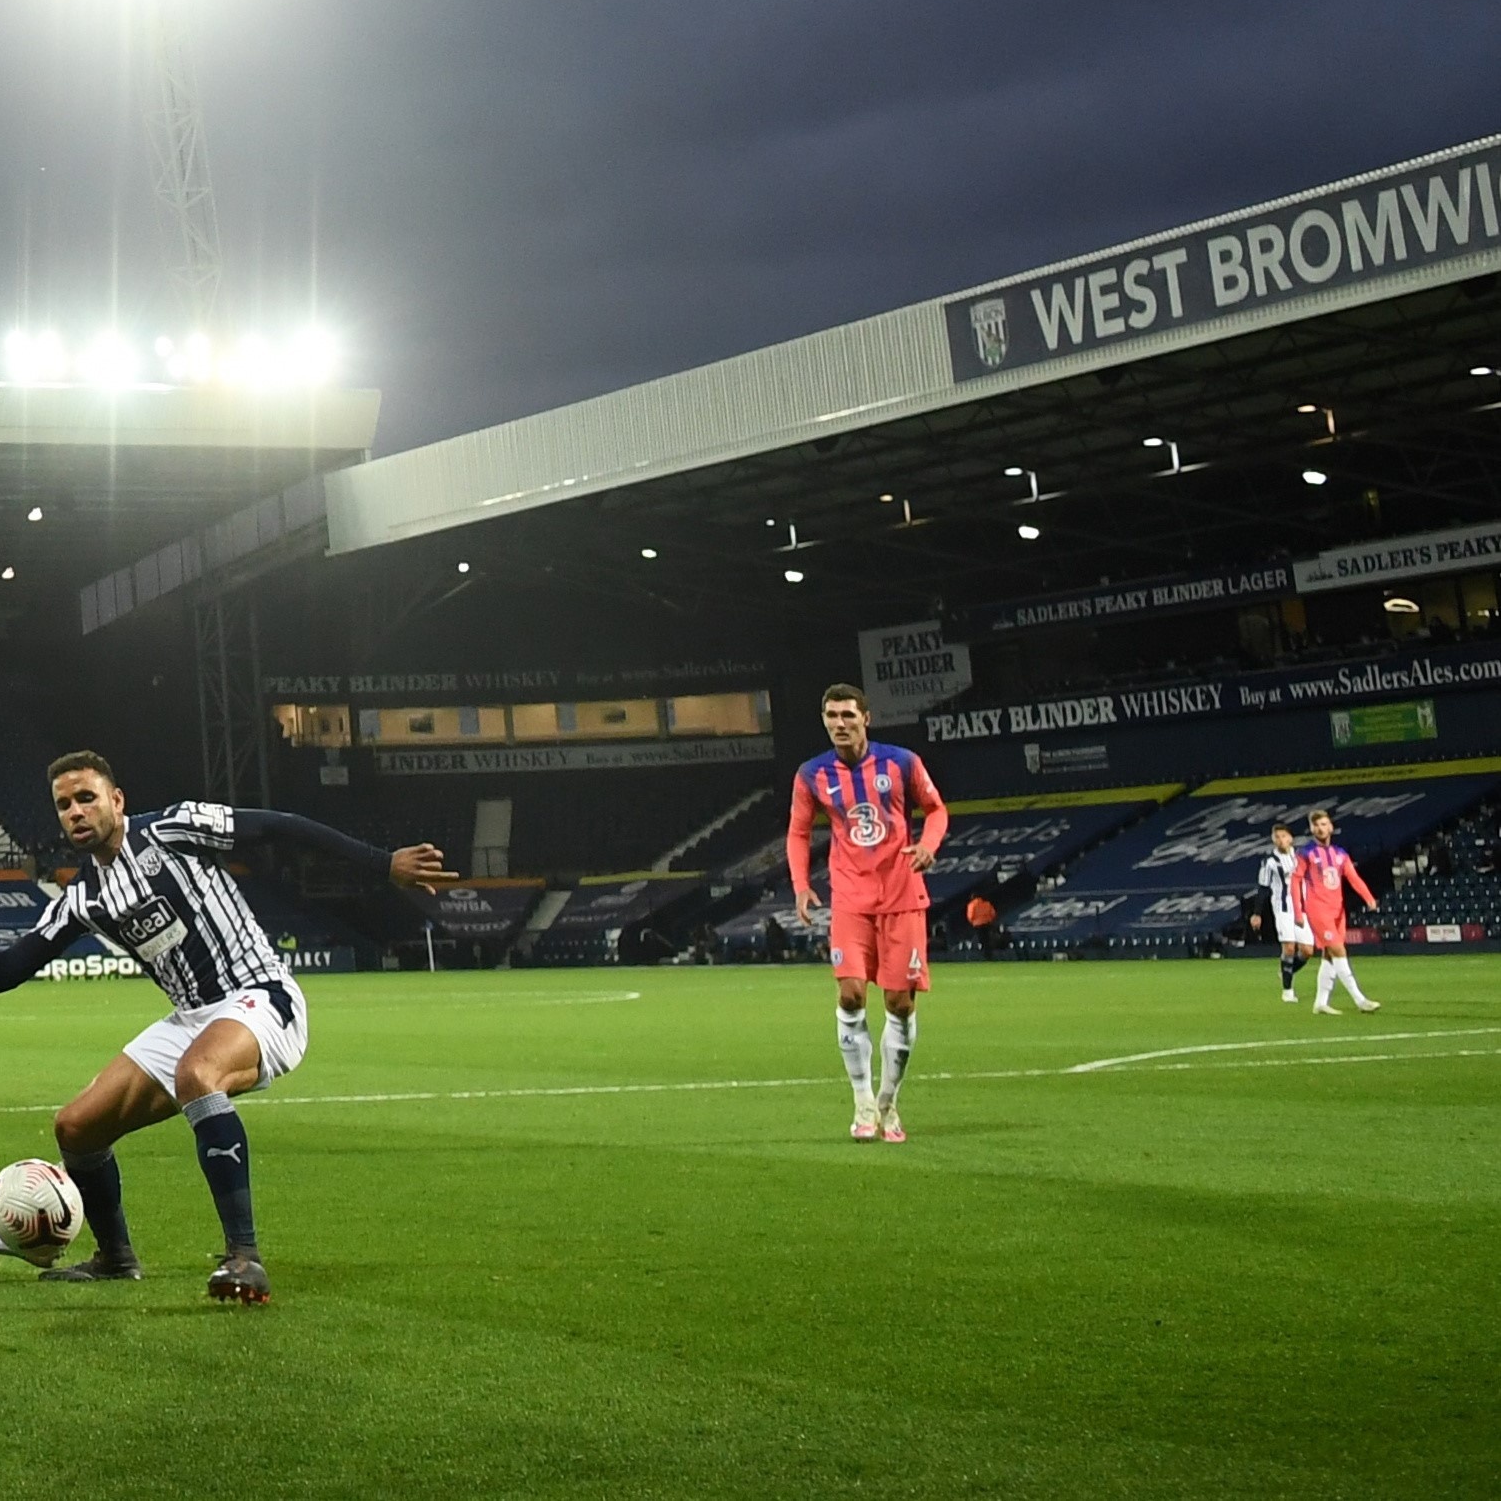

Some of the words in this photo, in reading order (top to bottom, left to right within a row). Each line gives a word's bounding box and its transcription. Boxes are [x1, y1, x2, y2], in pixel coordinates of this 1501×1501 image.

[1031, 248, 1188, 352] WEST
[1206, 162, 1501, 308] BROMWI
[1337, 545, 1433, 577] SADLER'S
[1016, 598, 1093, 627] SADLER'S
[1094, 589, 1149, 616] PEAKY
[1151, 577, 1225, 606] BLINDER
[1228, 568, 1288, 595] LAGER
[882, 629, 944, 658] PEAKY
[875, 652, 956, 682] BLINDER
[265, 675, 342, 693] PEAKY
[350, 674, 459, 692] BLINDER
[926, 708, 1001, 742] PEAKY
[1008, 695, 1117, 734] BLINDER
[1120, 683, 1223, 720] WHISKEY
[1239, 685, 1266, 711] Buy
[1268, 686, 1282, 704] at
[125, 901, 172, 943] ideal
[282, 950, 332, 967] DARCY
